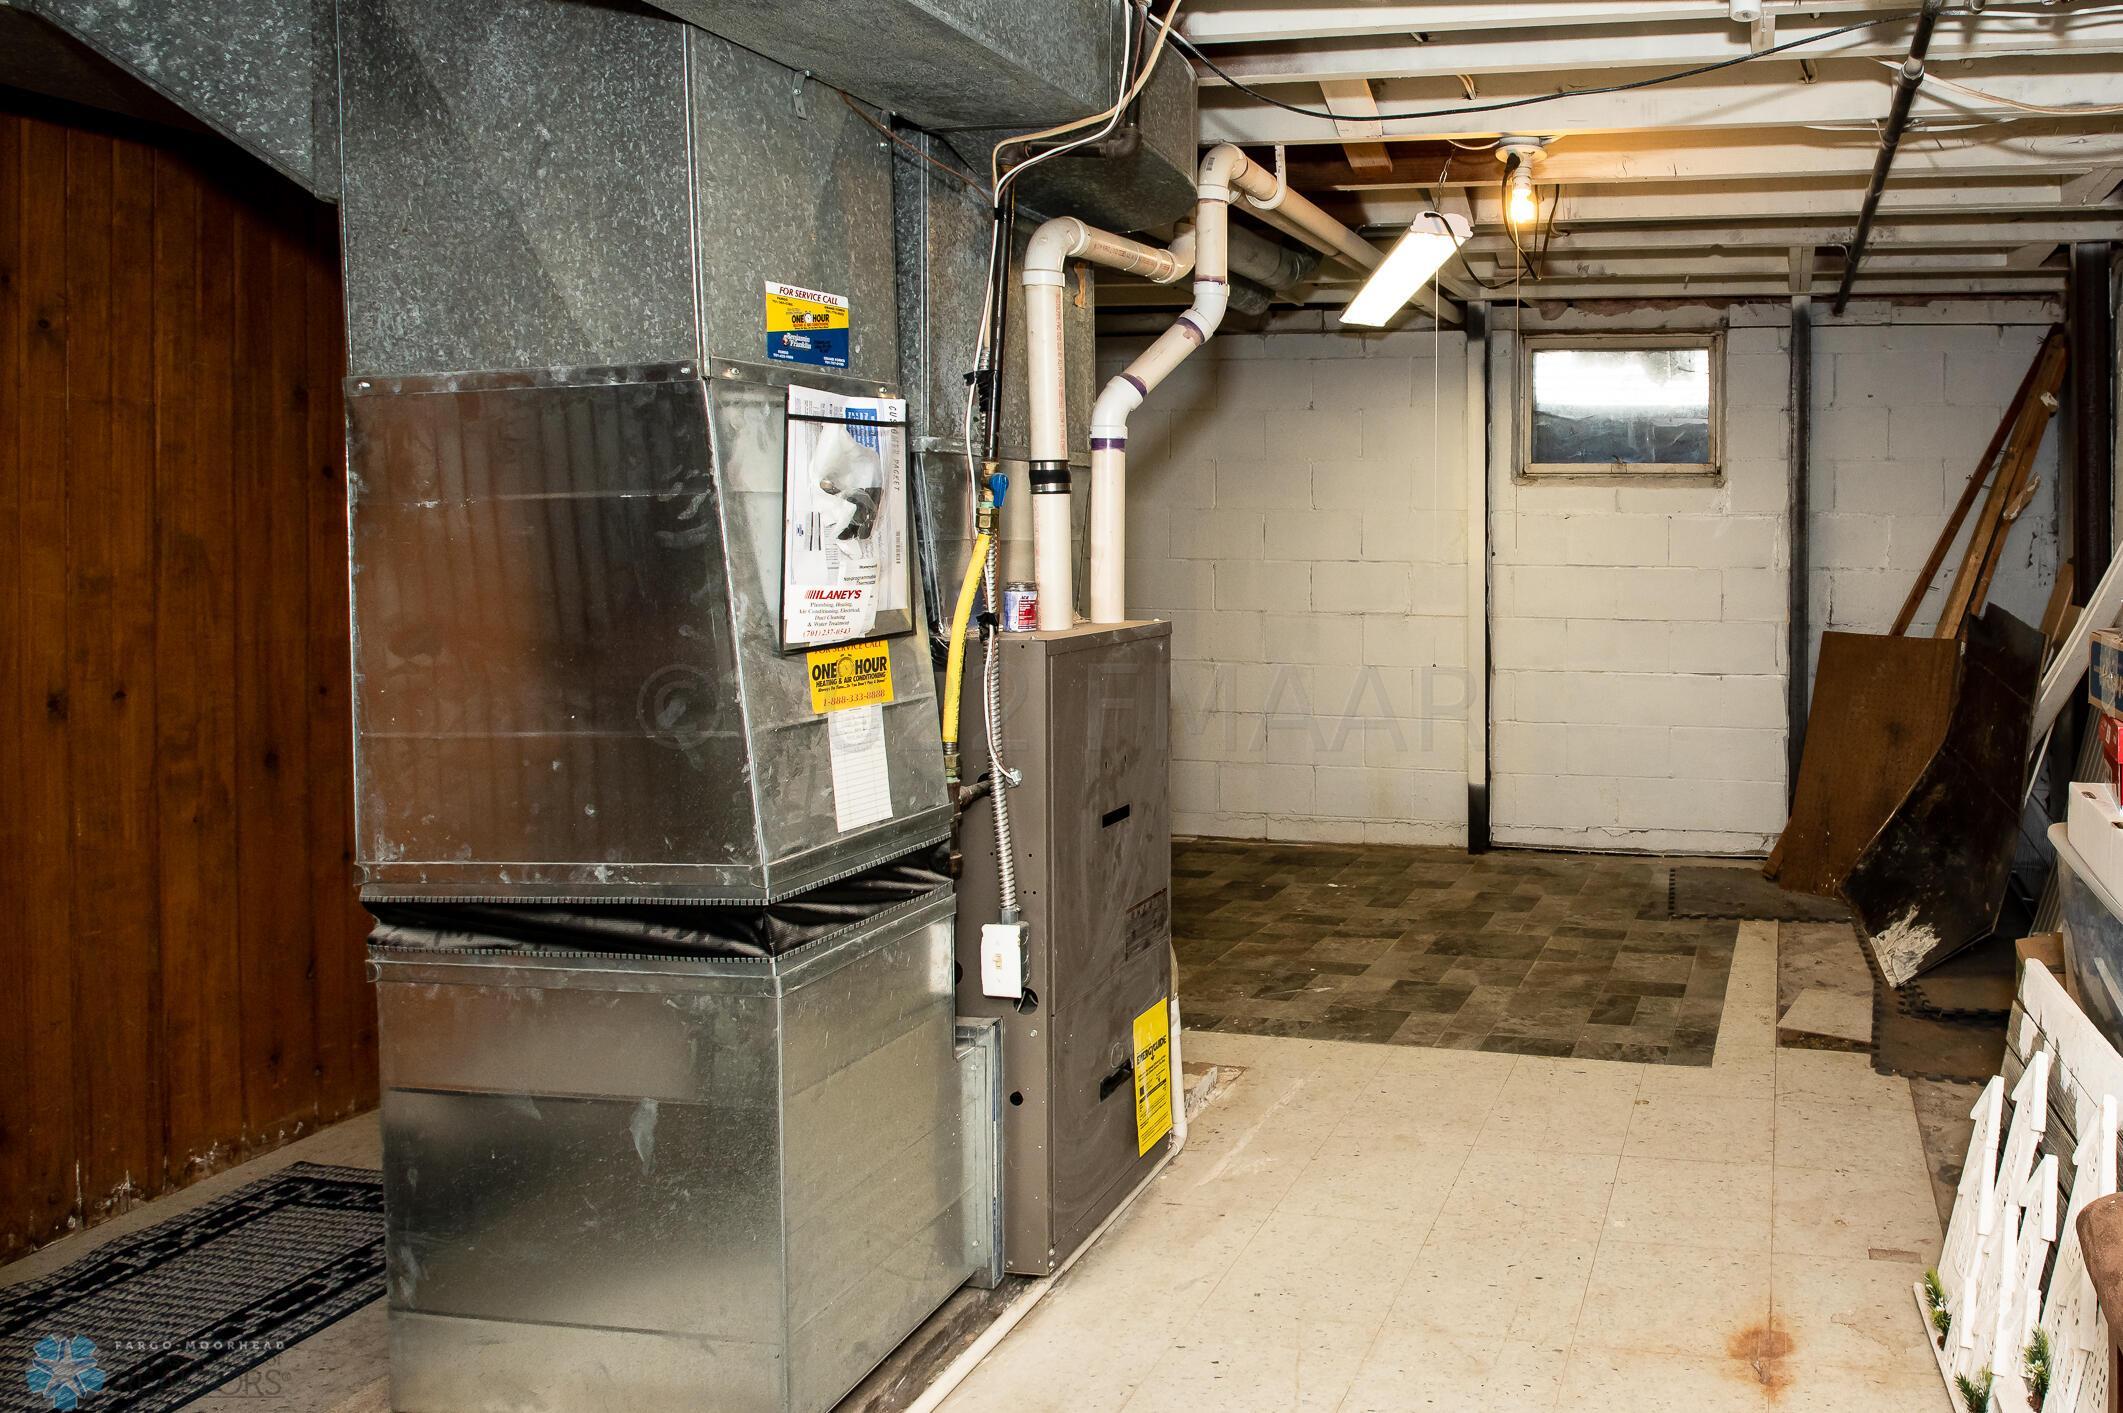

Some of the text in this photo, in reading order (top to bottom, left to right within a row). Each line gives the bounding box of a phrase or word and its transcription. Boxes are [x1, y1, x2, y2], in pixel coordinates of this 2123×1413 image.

[780, 287, 838, 305] FOR SERVICE CALL
[792, 314, 830, 323] ONE HOUR
[819, 590, 862, 599] LANEY'S
[812, 656, 887, 681] ONE HOUR
[816, 679, 837, 687] HEATING
[853, 672, 886, 682] CONDITIONING
